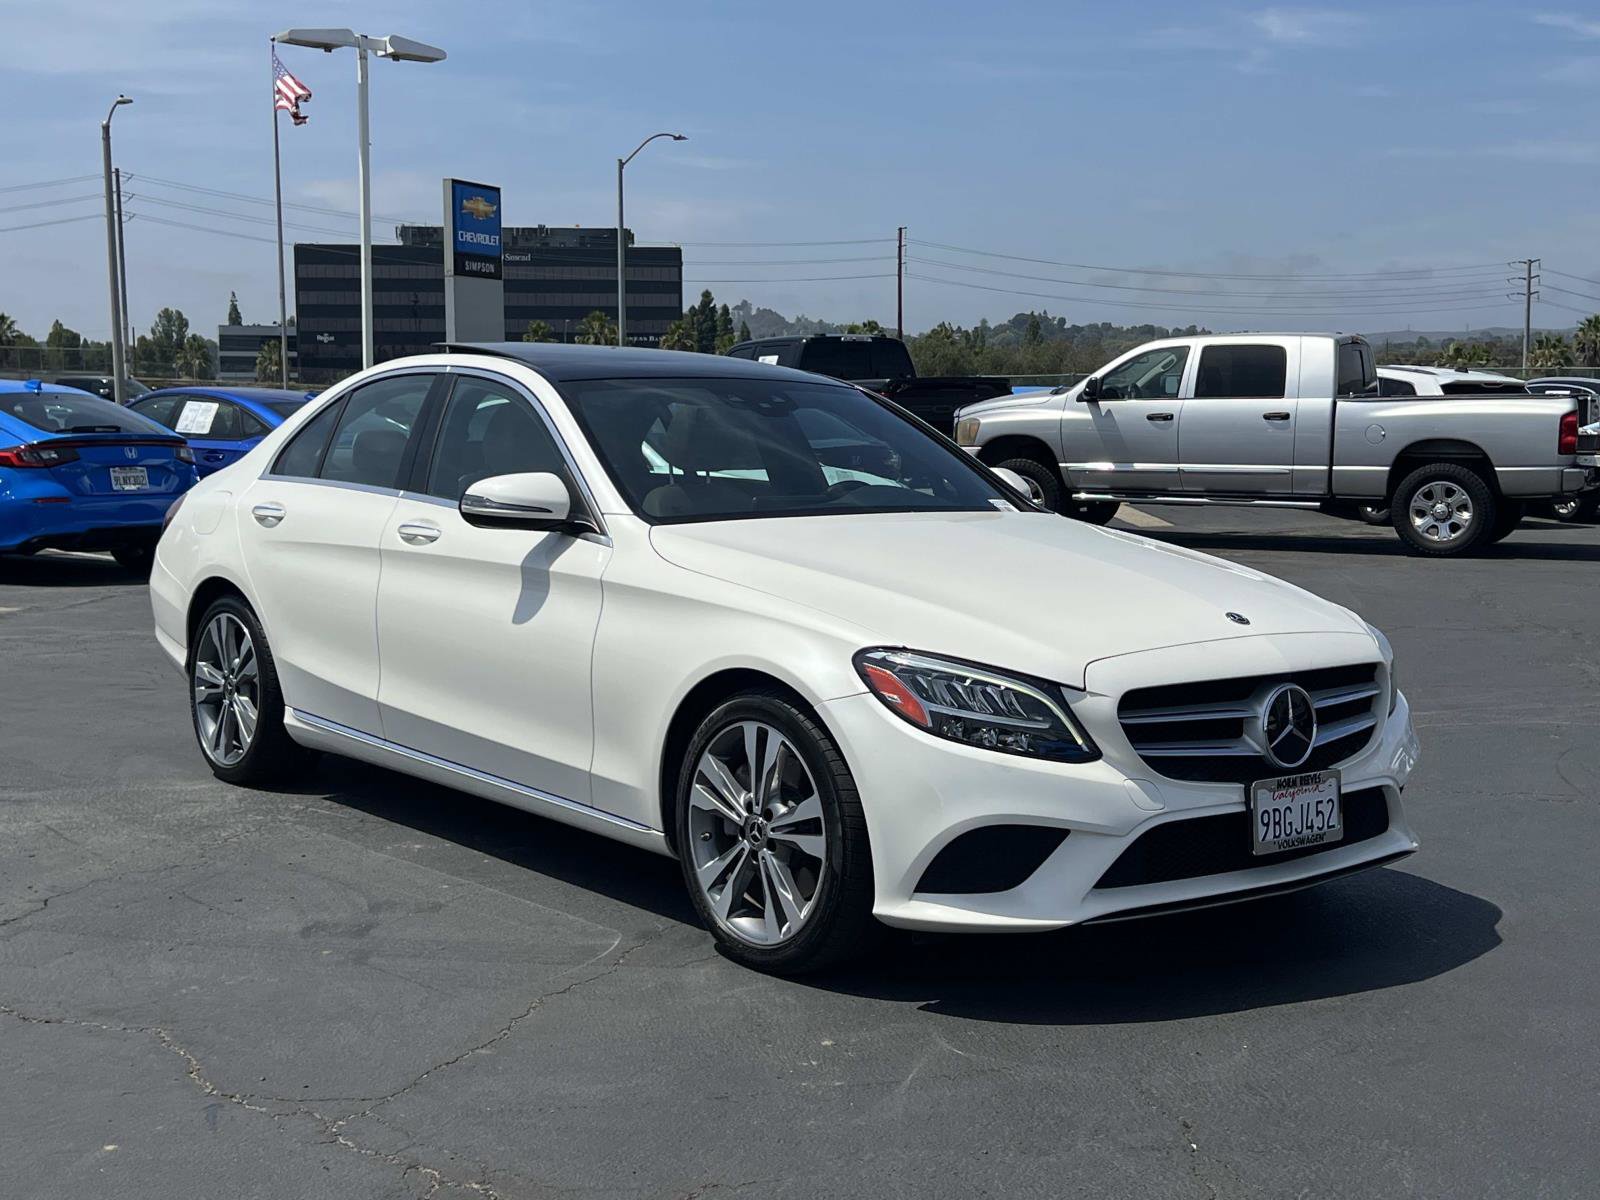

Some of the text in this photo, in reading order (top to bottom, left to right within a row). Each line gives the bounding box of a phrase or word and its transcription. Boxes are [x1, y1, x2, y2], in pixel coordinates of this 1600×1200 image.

[458, 231, 499, 246] CHEVROLET
[465, 260, 495, 273] SIMPSON
[1272, 784, 1325, 802] California
[1260, 798, 1336, 842] 9BGJ452
